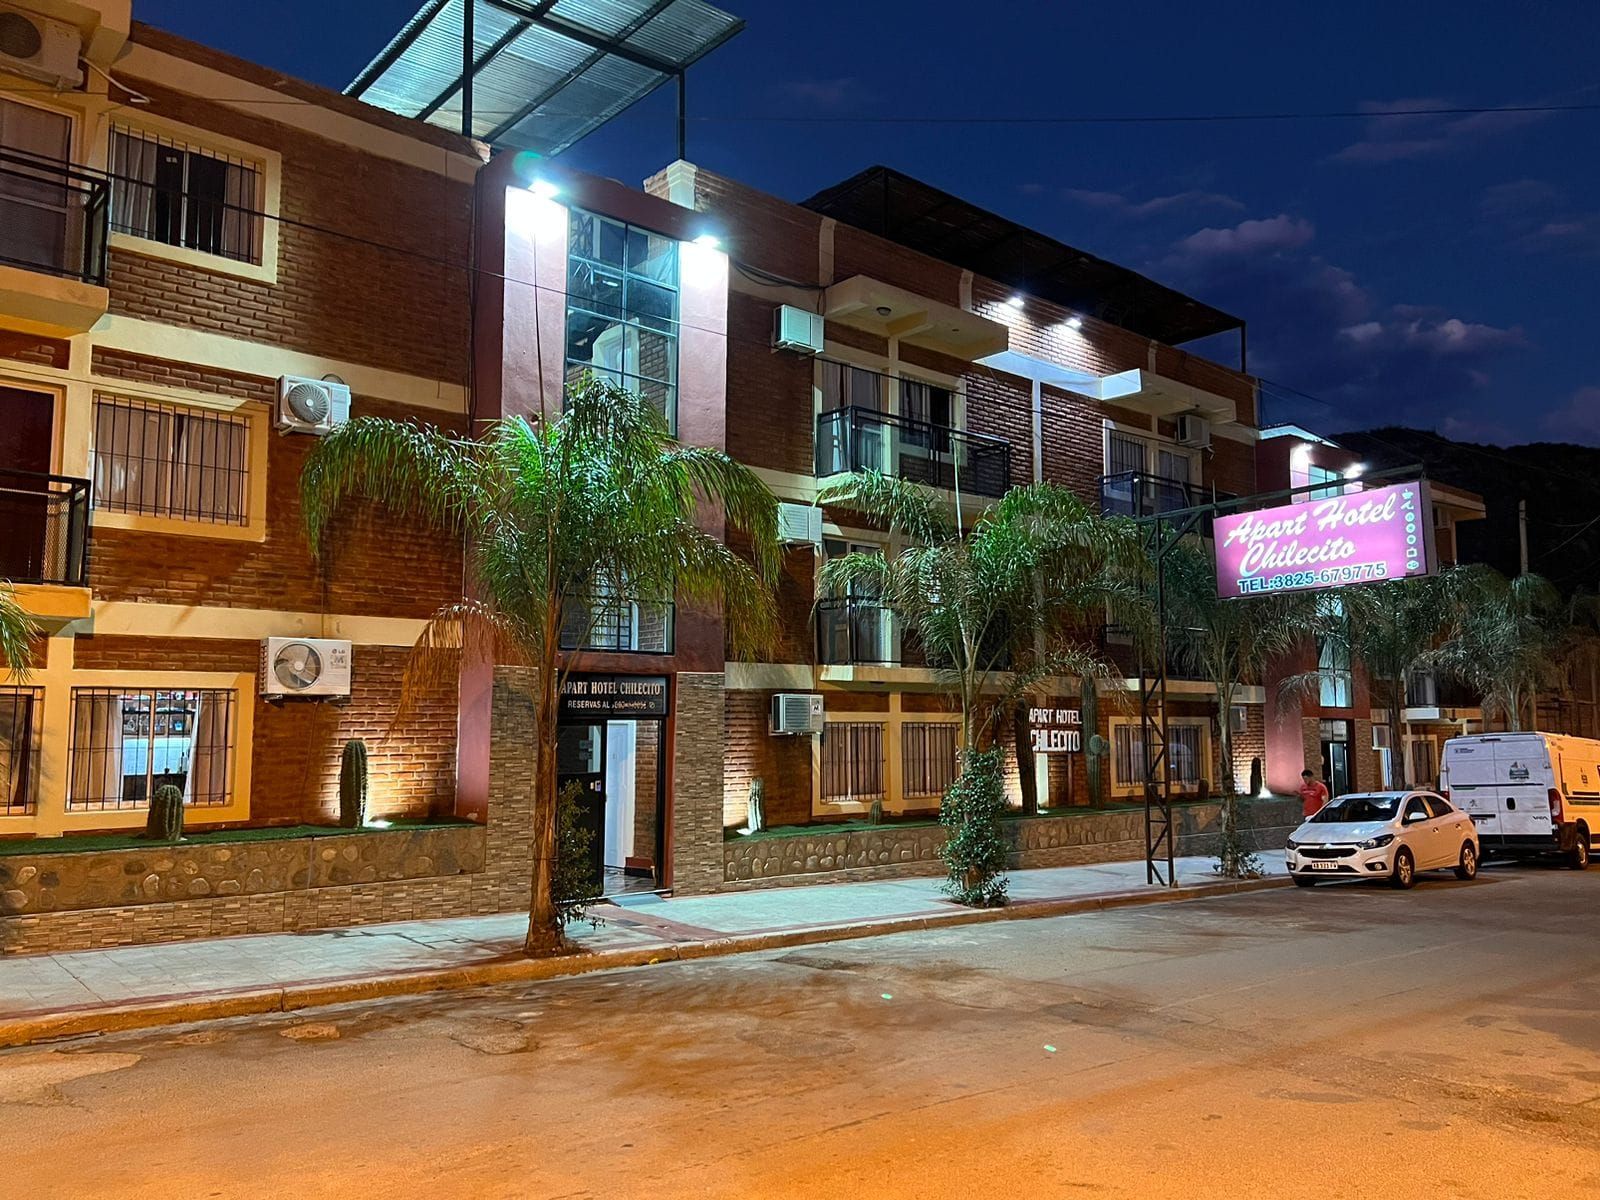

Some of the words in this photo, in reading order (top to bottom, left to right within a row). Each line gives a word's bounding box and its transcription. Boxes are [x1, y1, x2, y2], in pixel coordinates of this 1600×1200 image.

[1224, 512, 1307, 547] Apart
[1313, 492, 1397, 531] Hotel
[1239, 537, 1356, 577] Chilecito
[1238, 562, 1387, 593] TEL:3825-679775
[561, 682, 588, 695] APART
[591, 682, 617, 695] HOTEL
[620, 683, 660, 695] CHILECITO
[567, 700, 601, 708] RESERVAS
[1029, 708, 1053, 723] APART
[1056, 709, 1082, 724] HOTEL
[1030, 729, 1080, 752] CHILECITO
